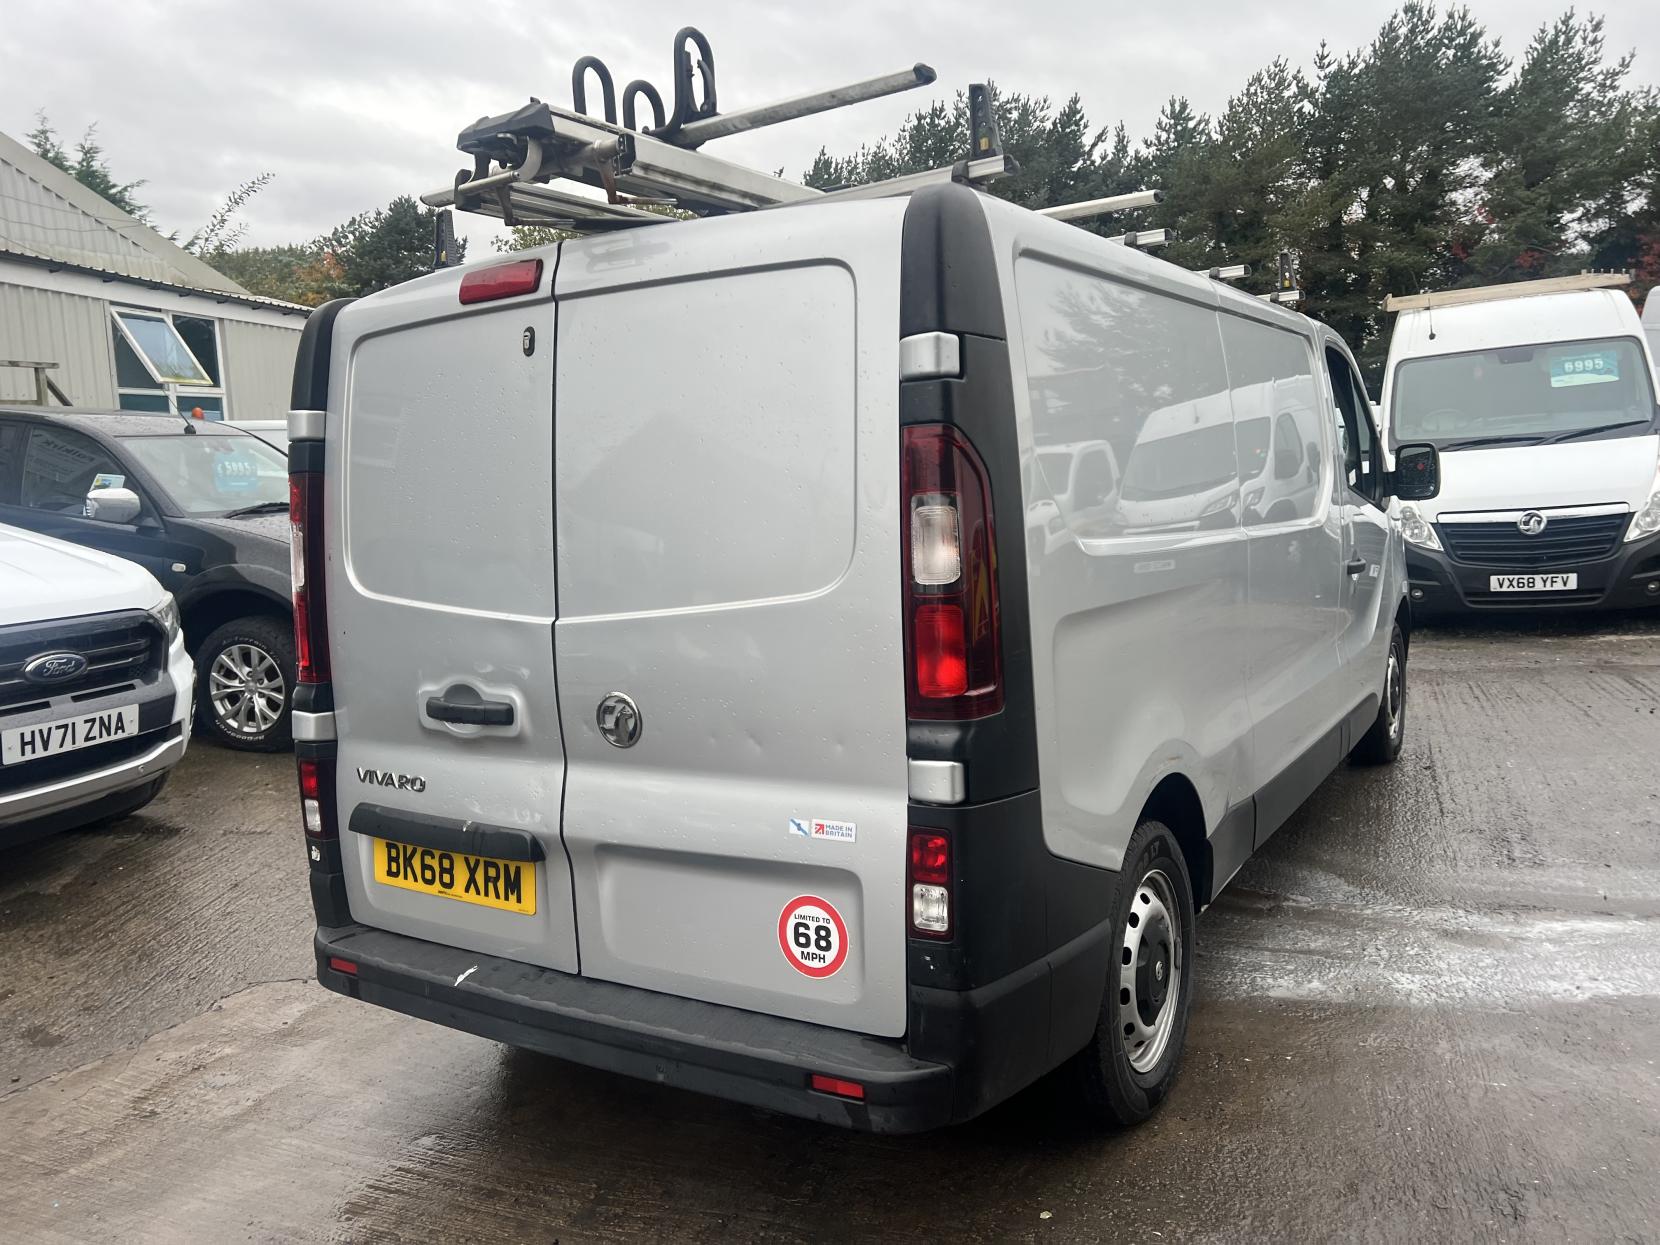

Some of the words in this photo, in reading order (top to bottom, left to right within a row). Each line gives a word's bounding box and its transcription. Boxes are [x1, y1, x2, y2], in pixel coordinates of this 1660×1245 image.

[1564, 358, 1604, 373] 6995
[1497, 576, 1536, 589] VX68
[1540, 575, 1570, 588] YFV
[43, 658, 76, 676] Ford
[20, 721, 76, 757] HV71
[83, 711, 126, 743] ZNA
[356, 767, 426, 793] VIVARO
[825, 823, 844, 832] MADE
[825, 830, 853, 838] BRITAIN
[385, 841, 455, 889] BK68
[463, 856, 522, 904] XRM
[794, 913, 821, 923] LIMITED
[821, 917, 831, 925] TO
[794, 921, 832, 952] 68
[800, 950, 826, 964] MPH
